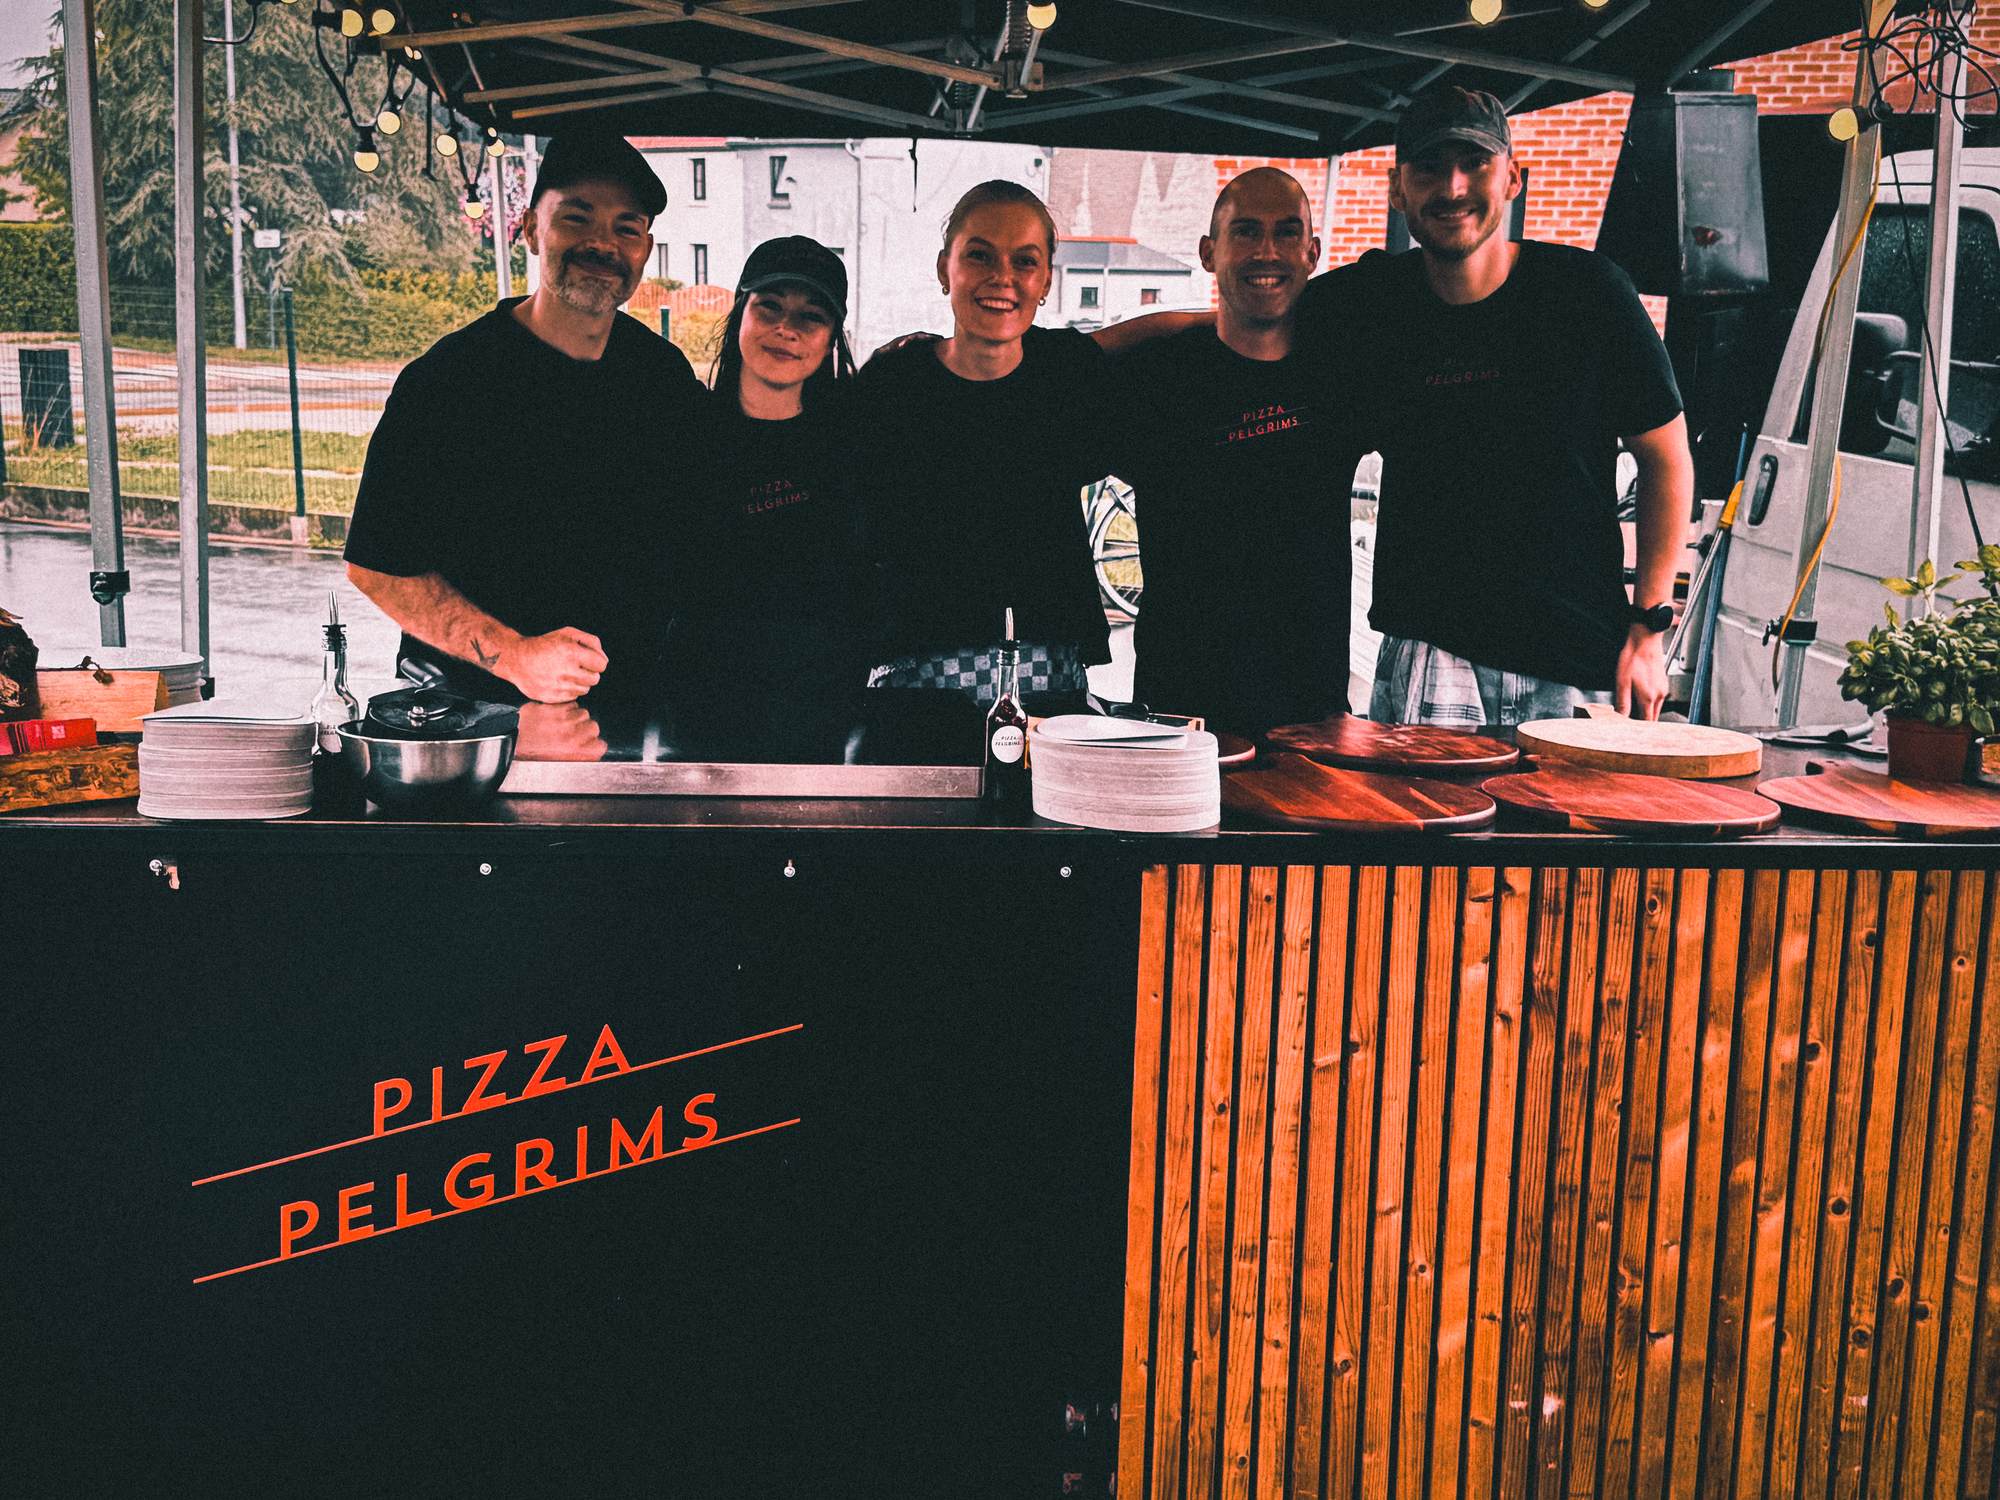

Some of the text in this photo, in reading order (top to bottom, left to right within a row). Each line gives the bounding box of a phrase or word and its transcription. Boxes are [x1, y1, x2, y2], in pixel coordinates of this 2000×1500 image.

[1228, 416, 1298, 441] PELGRIMS
[1242, 404, 1286, 423] PIZZA
[373, 1023, 633, 1137] PIZZA
[280, 1092, 720, 1260] PELGRIMS
